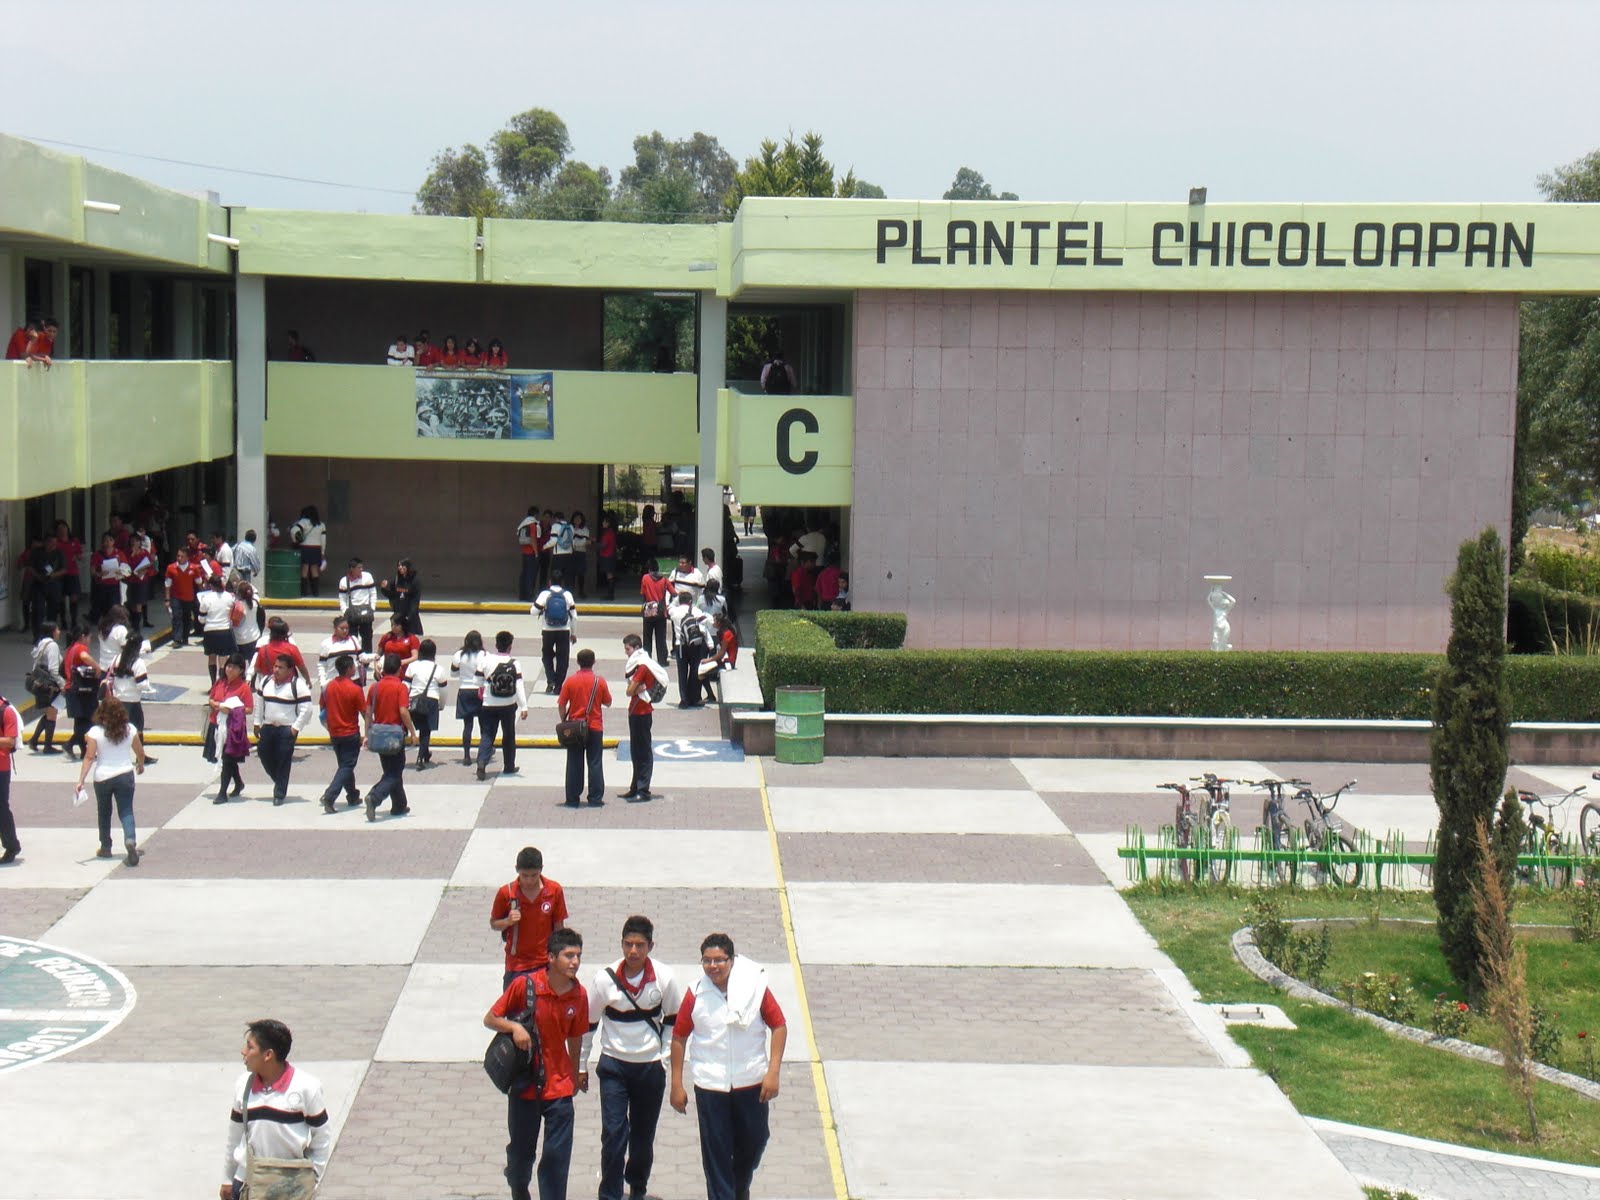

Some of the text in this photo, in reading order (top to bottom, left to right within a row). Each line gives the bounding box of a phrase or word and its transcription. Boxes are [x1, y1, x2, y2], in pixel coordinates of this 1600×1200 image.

[876, 219, 1536, 268] PLANTEL CHICOLOAPAN
[776, 407, 820, 476] C
